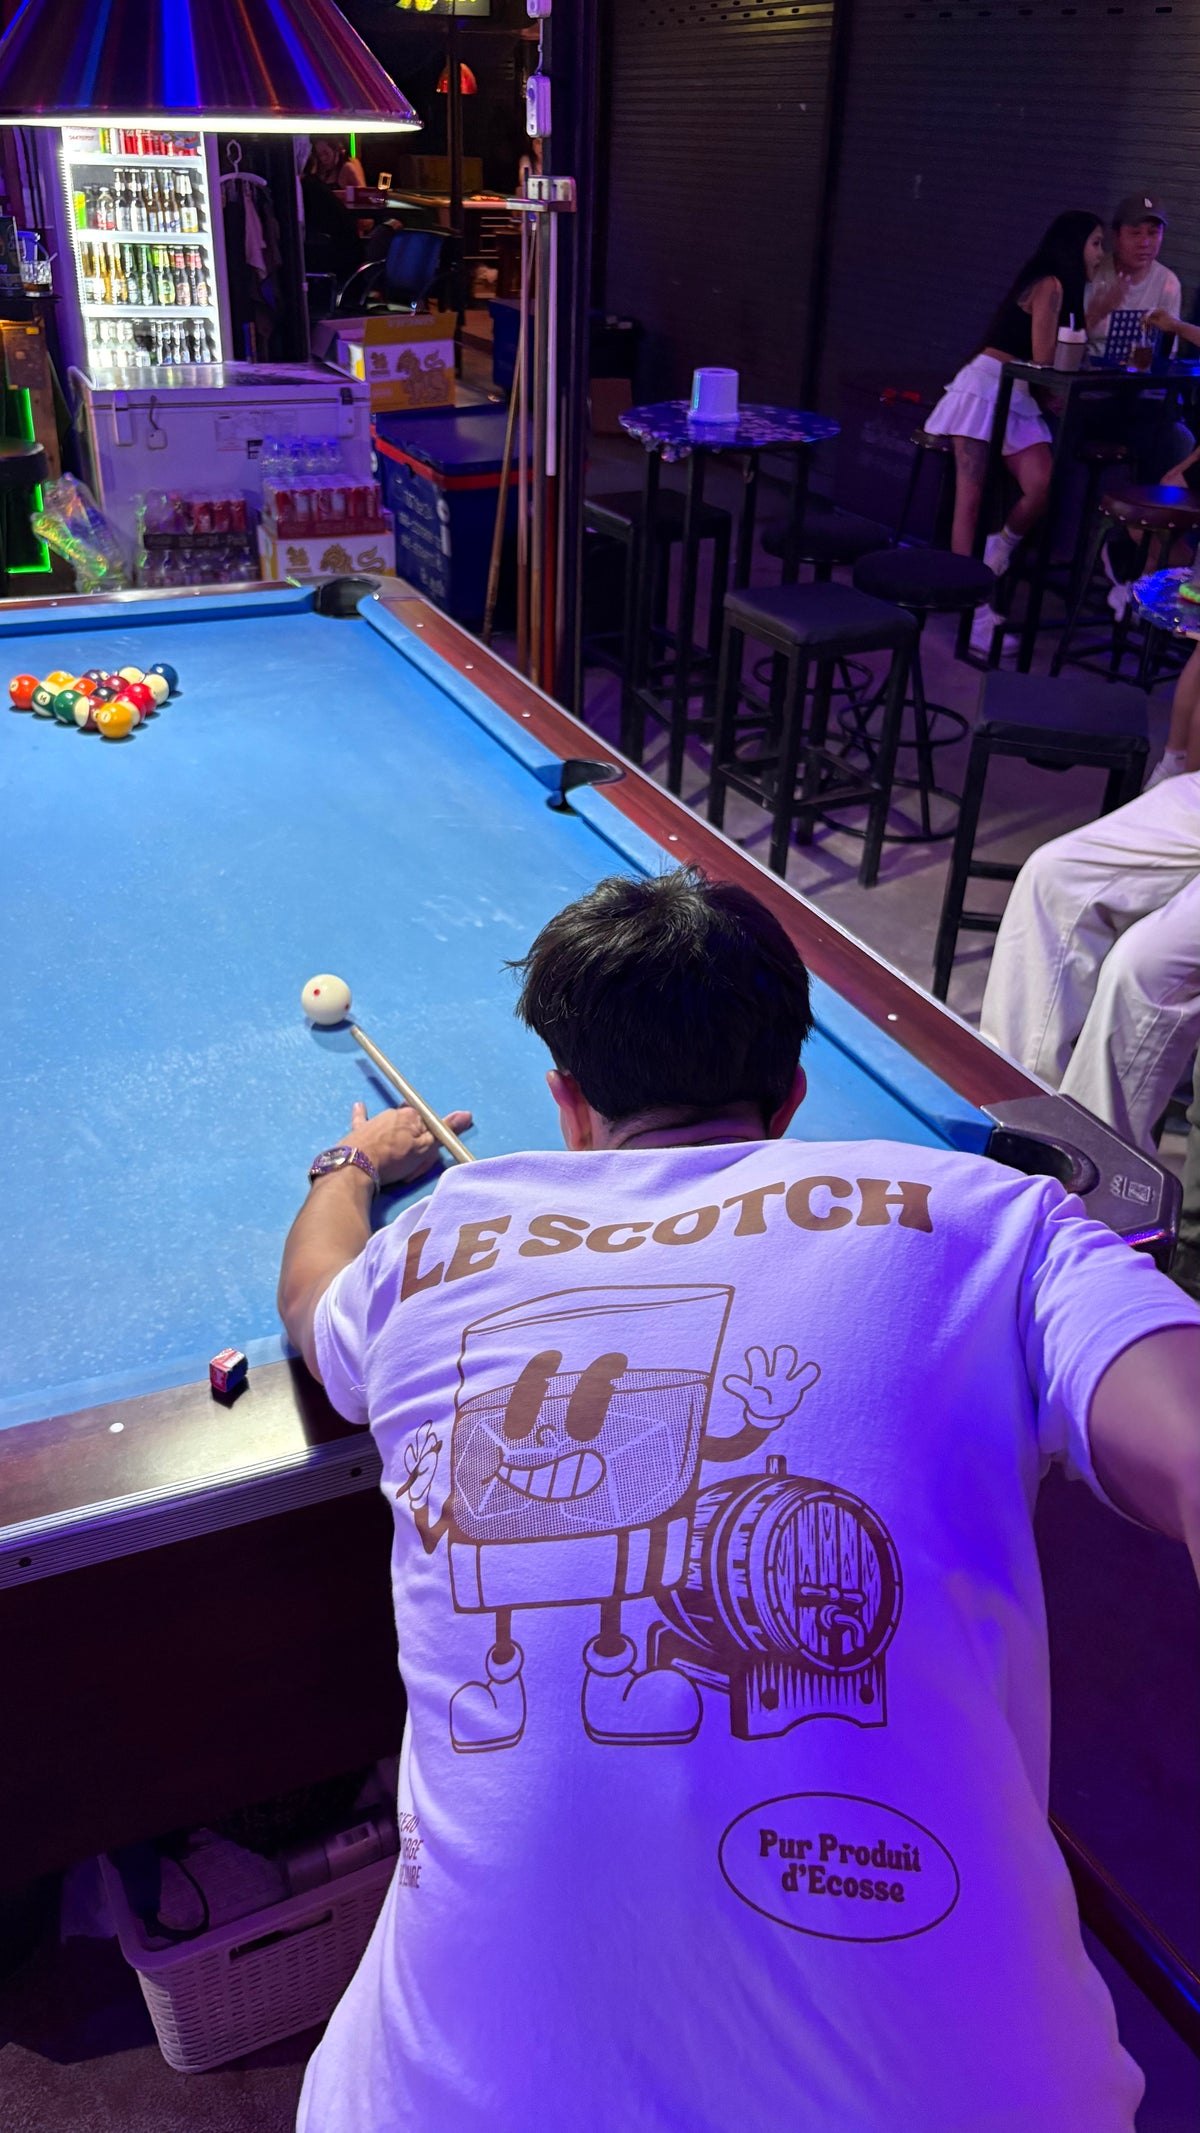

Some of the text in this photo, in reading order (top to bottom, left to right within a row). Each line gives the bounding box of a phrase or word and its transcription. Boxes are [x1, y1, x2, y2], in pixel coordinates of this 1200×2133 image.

[400, 1175, 934, 1304] LE SCOTCH
[759, 1828, 922, 1873] Pur Produit
[781, 1863, 906, 1904] d'Ecosse
